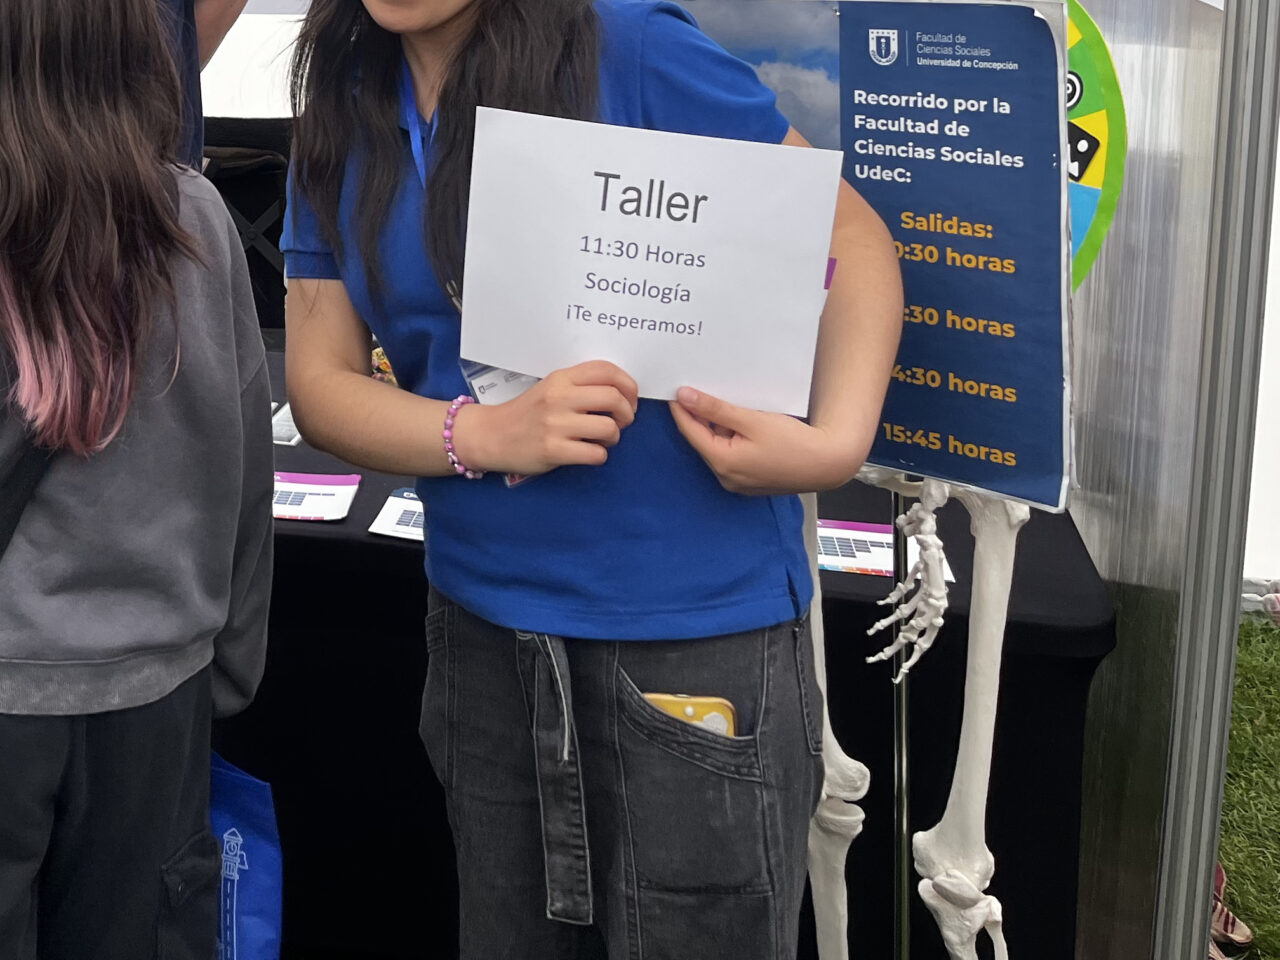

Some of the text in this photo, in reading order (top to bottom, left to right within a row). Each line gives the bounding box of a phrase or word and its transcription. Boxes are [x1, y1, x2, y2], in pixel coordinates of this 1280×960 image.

[916, 31, 967, 44] Facultad de
[916, 43, 991, 57] Ciencias Sociales
[917, 56, 1018, 71] Universidad de Concepción
[853, 89, 1011, 115] Recorrido por la
[854, 114, 970, 138] Facultad de
[854, 139, 1025, 168] Ciencias Sociales
[854, 164, 912, 184] UdeC:
[593, 171, 709, 224] Taller
[900, 210, 994, 239] Salidas:
[579, 235, 707, 268] 11:30 Horas
[894, 240, 1016, 274] 0:30 horas
[584, 271, 691, 305] Sociología
[566, 304, 703, 337] ¡Te esperamos!
[903, 304, 1016, 338] :30 horas
[892, 364, 1017, 403] 4:30 horas
[882, 422, 1017, 467] 15:45 horas
